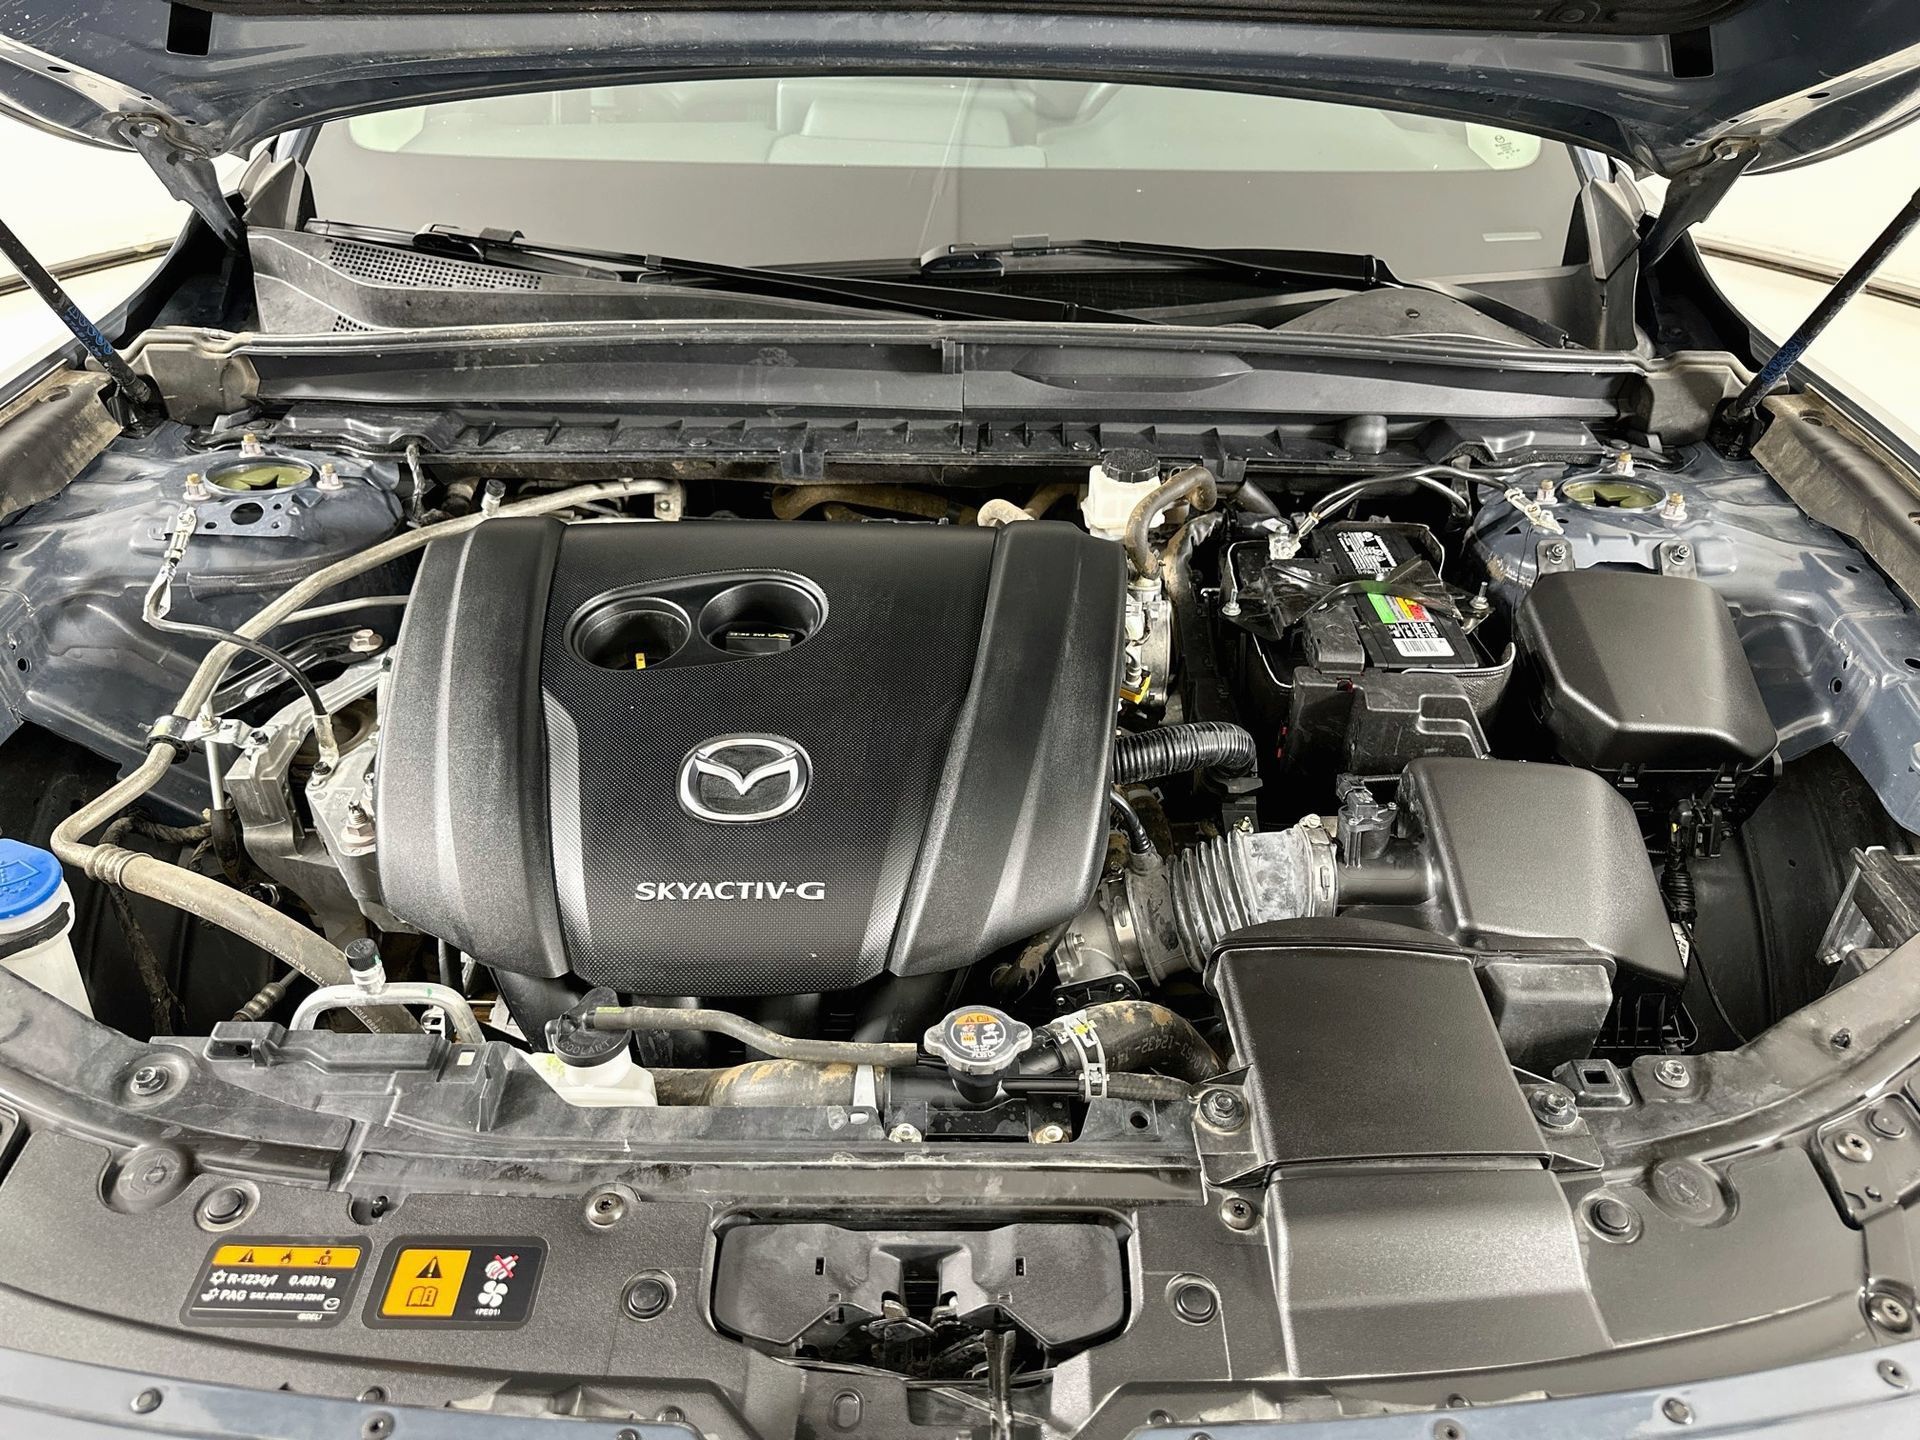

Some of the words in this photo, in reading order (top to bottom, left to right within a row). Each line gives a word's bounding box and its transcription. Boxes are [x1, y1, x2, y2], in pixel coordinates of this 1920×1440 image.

[634, 881, 826, 902] SKYACTIV-G
[560, 1039, 610, 1056] COOLANT
[226, 1273, 280, 1289] R-1234yf
[320, 1275, 337, 1290] kg
[219, 1289, 248, 1302] PAG
